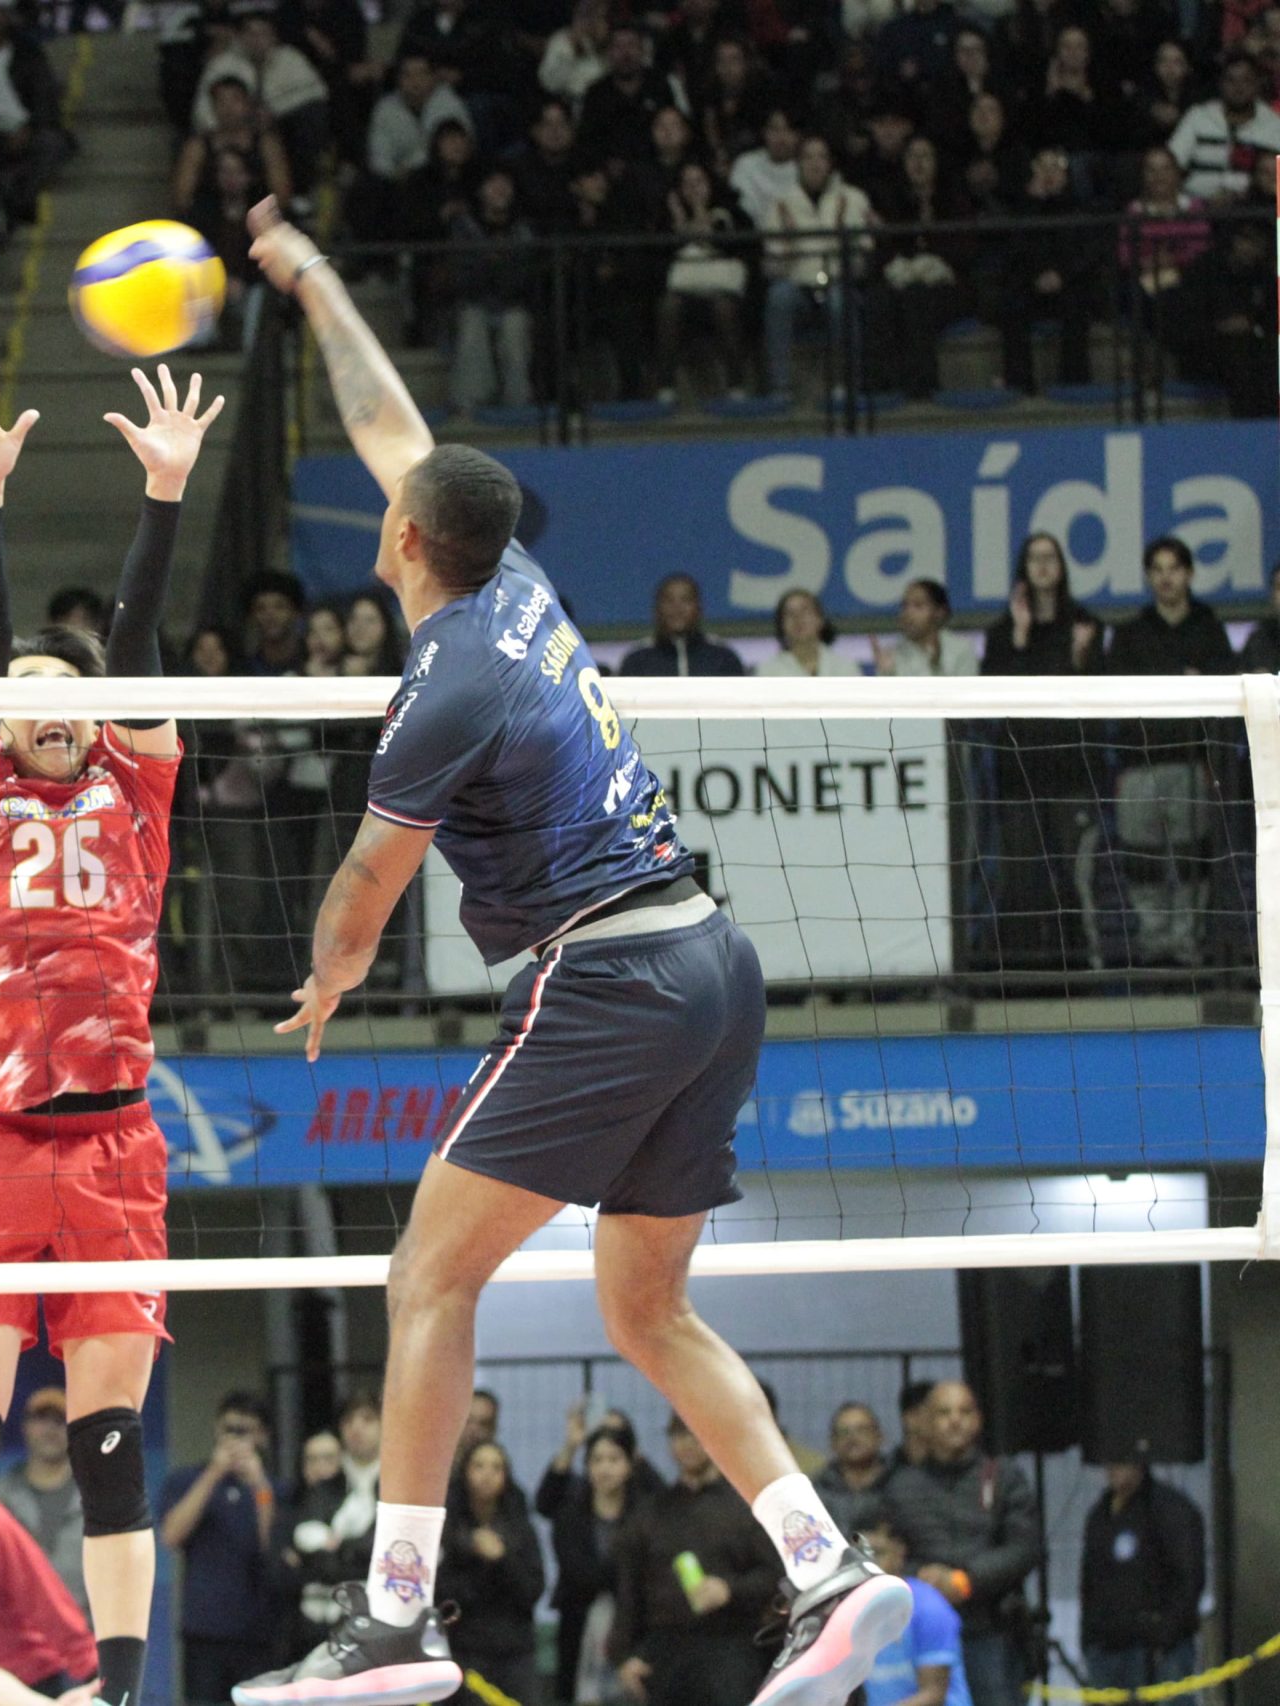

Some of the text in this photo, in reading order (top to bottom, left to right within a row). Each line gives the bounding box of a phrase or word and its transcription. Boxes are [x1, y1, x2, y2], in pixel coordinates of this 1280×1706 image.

[727, 432, 1264, 611] Saída
[578, 666, 620, 750] 8
[10, 819, 106, 909] 26
[840, 1089, 978, 1130] Suzano
